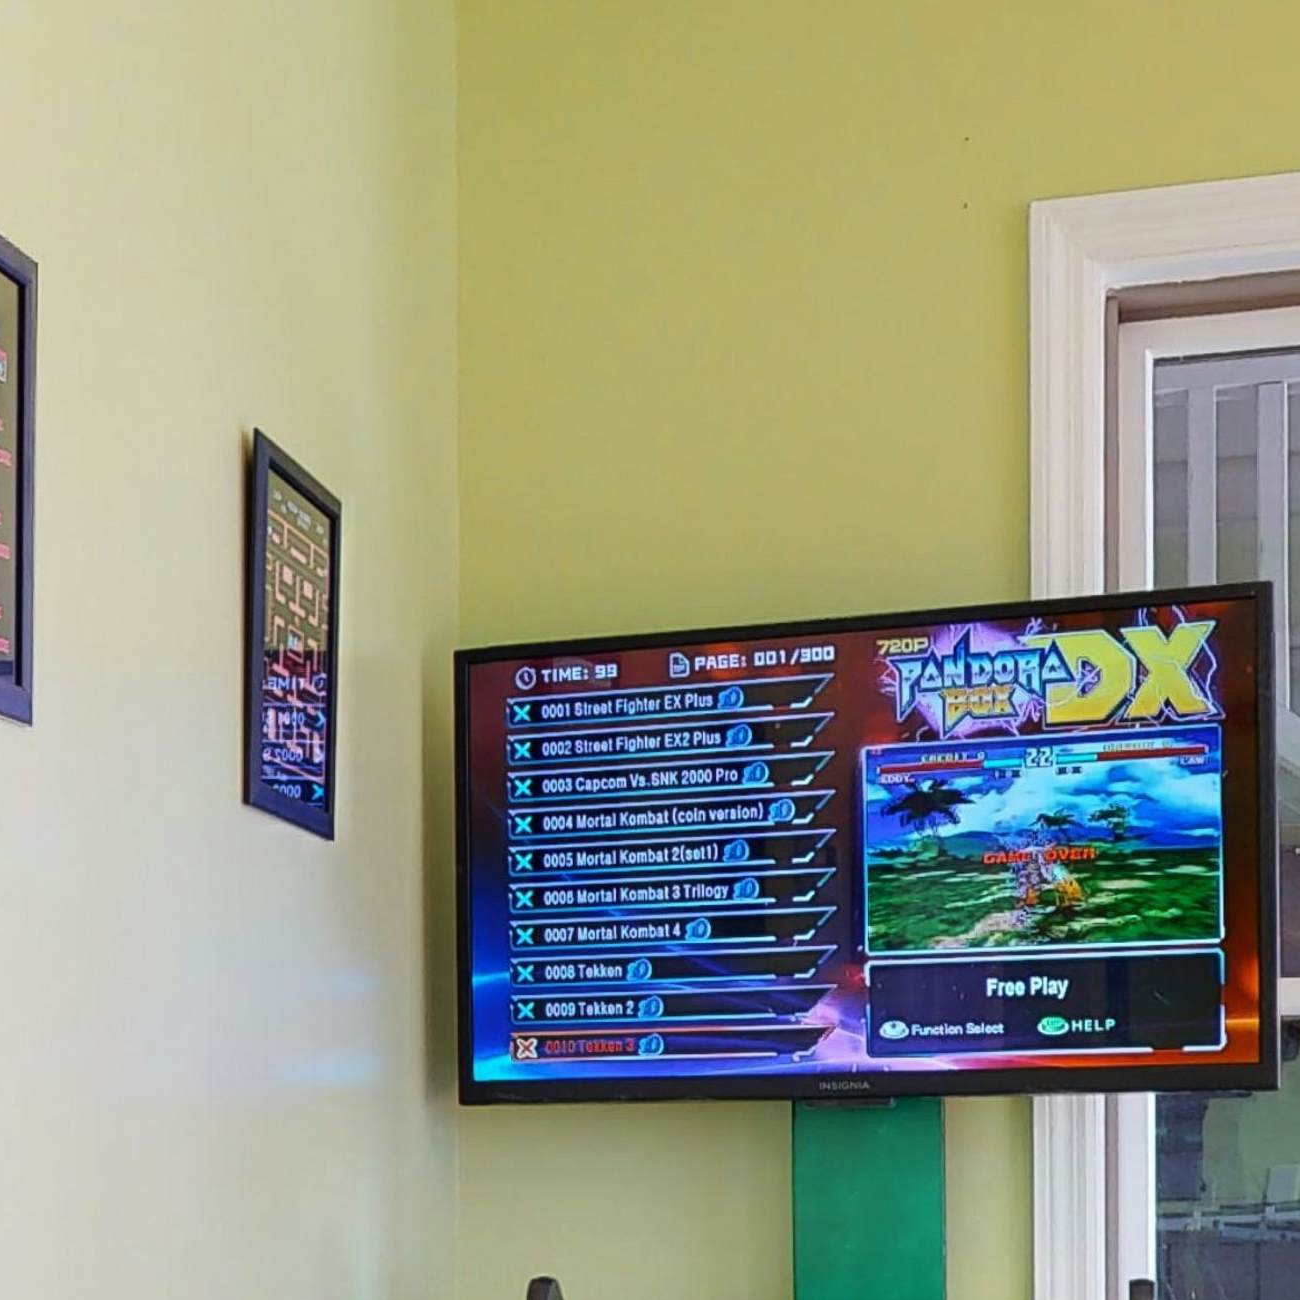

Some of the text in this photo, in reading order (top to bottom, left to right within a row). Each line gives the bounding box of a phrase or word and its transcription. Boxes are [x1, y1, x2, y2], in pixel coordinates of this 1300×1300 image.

[876, 637, 928, 656] 720P
[695, 654, 747, 671] PAGE:
[541, 667, 589, 684] TIME:
[894, 620, 1216, 730] PANDORA DX
[541, 692, 713, 720] 0001 Street Fighter EX Plus
[941, 687, 1017, 736] BOX
[542, 730, 721, 757] 0002 Street Fighter EX2 Plus
[1025, 747, 1054, 768] 22
[542, 778, 573, 794] 0003
[576, 774, 626, 792] Capcom
[681, 769, 712, 785] 2000
[716, 767, 738, 782] Pro
[543, 803, 763, 831] 0004 Mortal Kombat (coin version)
[543, 853, 573, 868] 0005
[577, 850, 617, 867] Mortal
[620, 848, 668, 864] Kombat
[983, 847, 1095, 865] GAME OVER
[544, 882, 729, 906] 0006 Mortal Kombat 3 Trilogy
[544, 923, 681, 943] 0007 Mortal Kombat 4
[545, 964, 622, 980] 0008 Tekken
[986, 976, 1069, 999] Free Play
[545, 1000, 634, 1018] 0009 Tekken 2
[911, 1020, 1004, 1037] Function Select
[1071, 1018, 1116, 1032] HELP
[544, 1041, 574, 1055] 0010
[578, 1039, 622, 1053] Tekken
[818, 1081, 870, 1091] INSIGNIA
